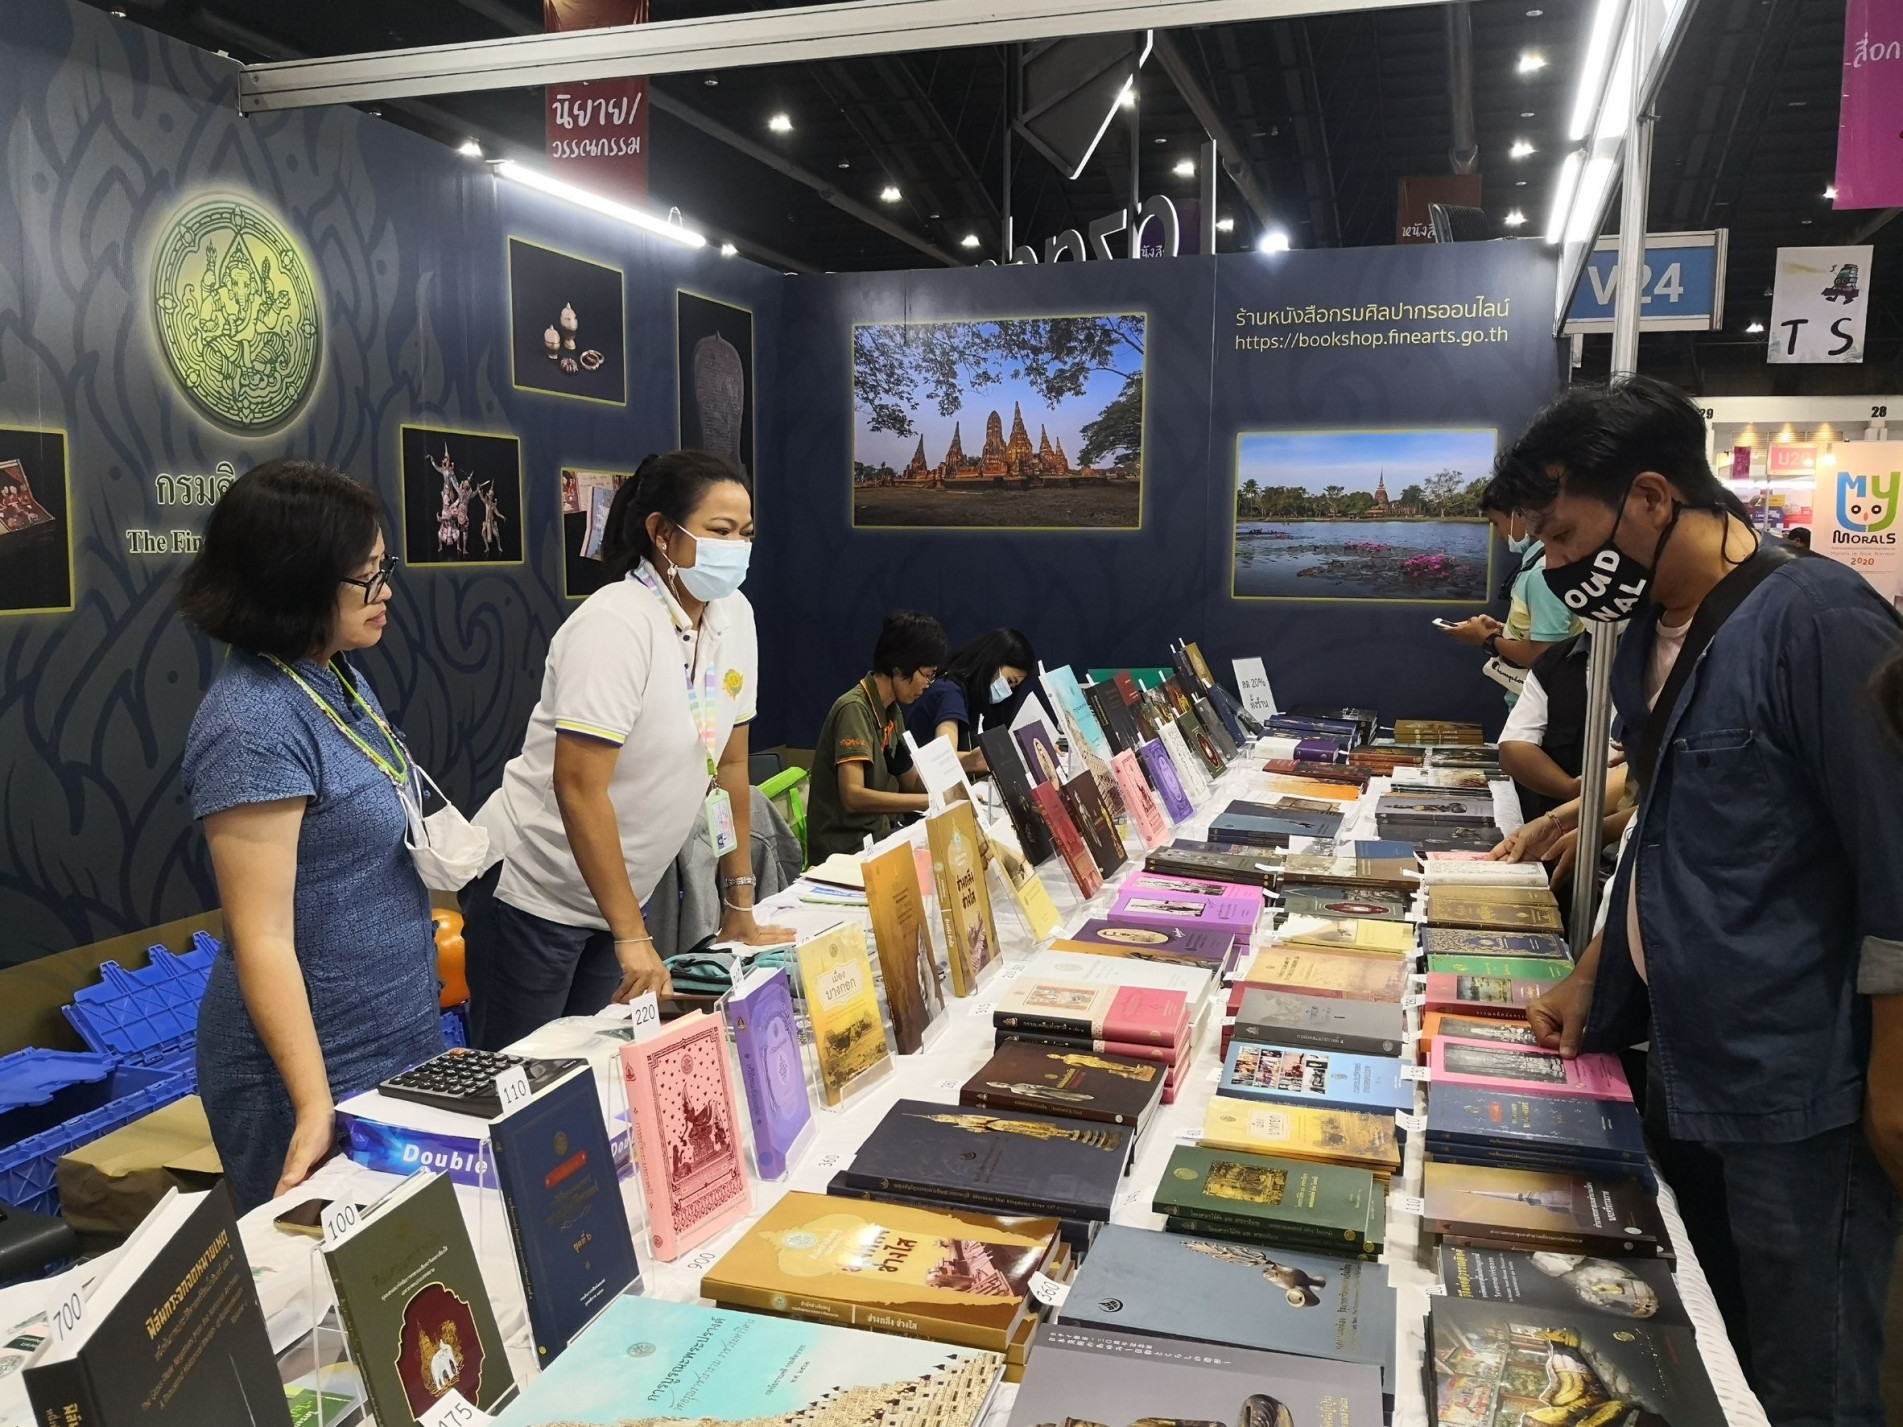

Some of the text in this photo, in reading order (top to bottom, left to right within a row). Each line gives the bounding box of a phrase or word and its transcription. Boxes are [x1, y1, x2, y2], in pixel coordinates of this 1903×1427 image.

[551, 92, 642, 129] นิยาย/
[552, 137, 641, 158] วรรณกรรม
[1235, 296, 1510, 327] ร้านหนังสือกรมศิลปากรออนไลน์
[1235, 326, 1509, 352] https://bookshop.finearts.go.th
[1871, 406, 1888, 418] 28
[126, 530, 166, 554] The
[1850, 557, 1875, 566] 2020
[825, 978, 857, 1000] บางกอก
[831, 970, 846, 984] เมือง
[635, 1003, 656, 1026] 220
[503, 1079, 527, 1104] 110
[402, 1143, 488, 1174] Double
[327, 1205, 355, 1241] 100
[687, 1252, 716, 1271] 900
[1036, 1280, 1060, 1303] 360
[53, 1292, 82, 1341] 700
[648, 1316, 726, 1401] การบูรณะพระปรางค์
